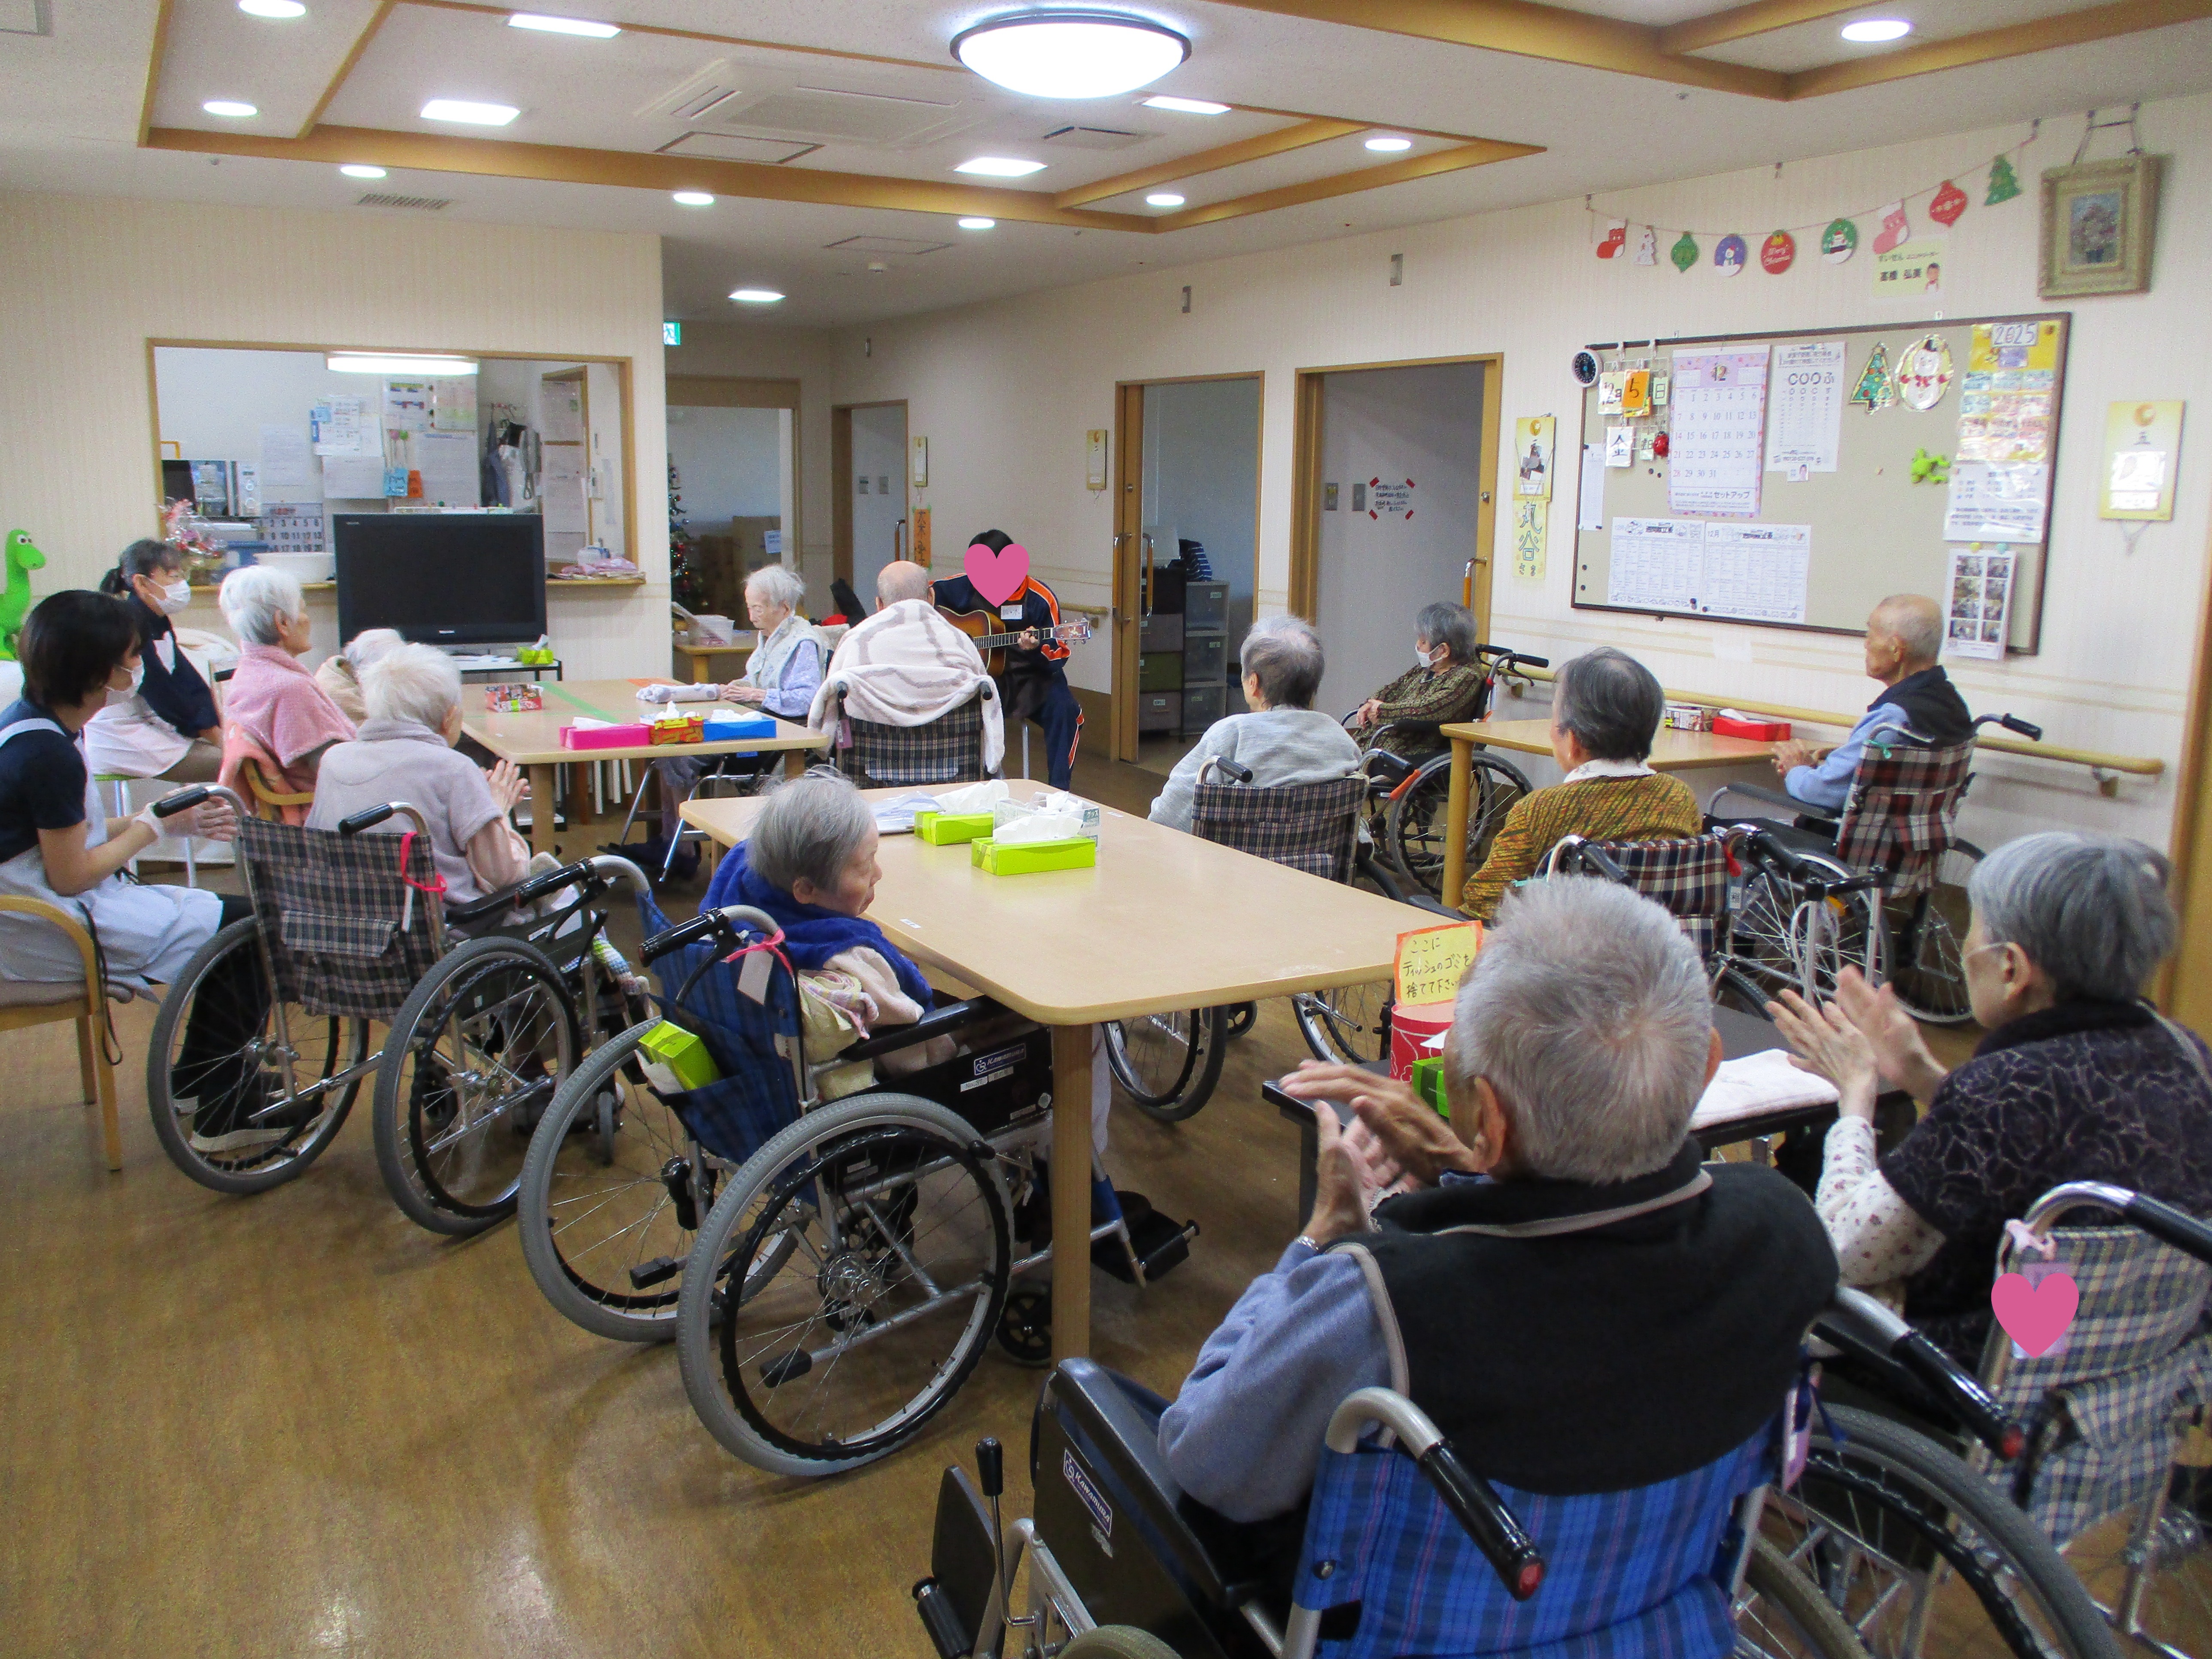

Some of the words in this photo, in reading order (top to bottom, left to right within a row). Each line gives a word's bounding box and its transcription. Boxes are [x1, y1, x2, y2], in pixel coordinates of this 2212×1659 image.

[1711, 365, 1726, 381] 12
[1629, 377, 1640, 398] 5
[1714, 491, 1750, 499] セットアップ
[1518, 501, 1543, 561] 丸谷
[1707, 530, 1720, 538] 12月
[1519, 562, 1536, 577] さま
[1411, 937, 1440, 954] ここに
[1403, 953, 1470, 976] ティッシュのゴミを
